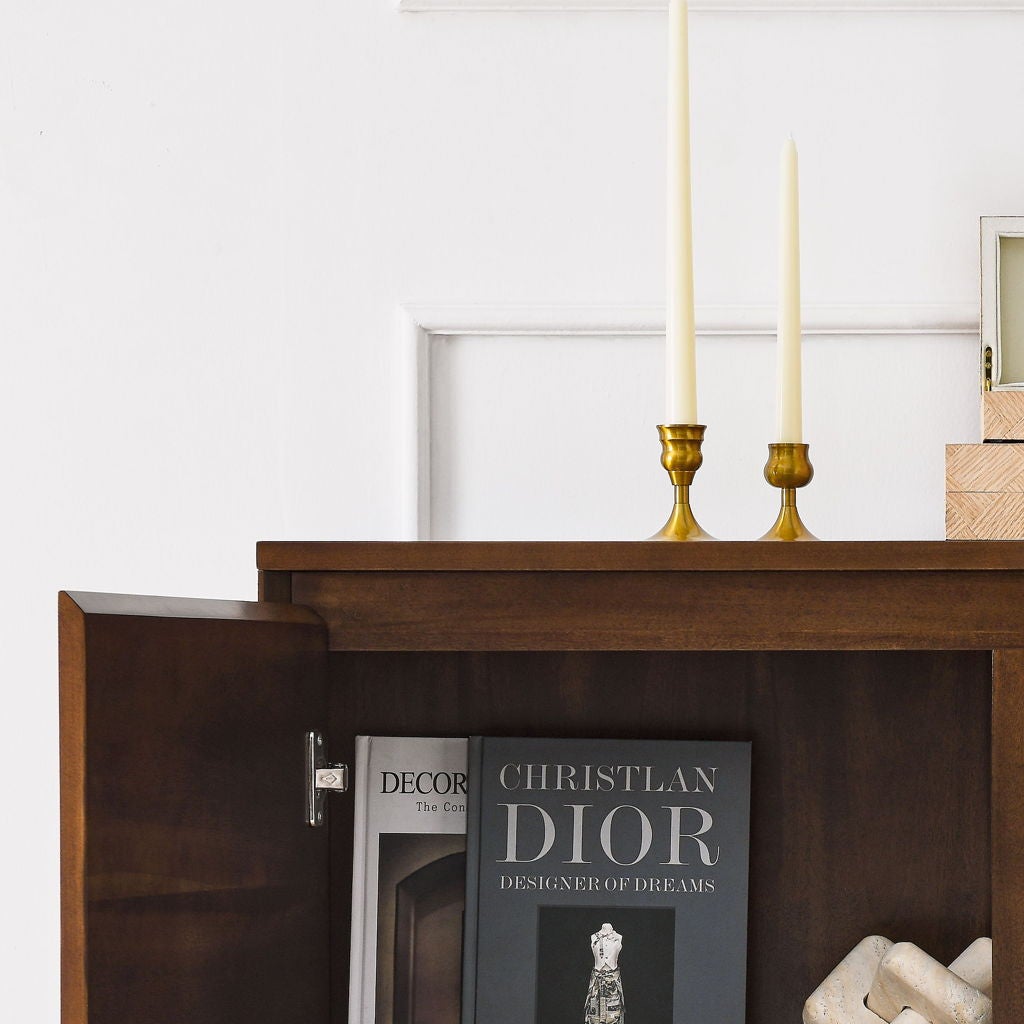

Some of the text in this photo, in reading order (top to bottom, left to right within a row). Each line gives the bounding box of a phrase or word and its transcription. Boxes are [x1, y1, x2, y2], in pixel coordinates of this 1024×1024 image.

[416, 801, 465, 812] The Con
[496, 802, 720, 866] DIOR
[500, 875, 715, 893] DESIGNER OF DREAMS
